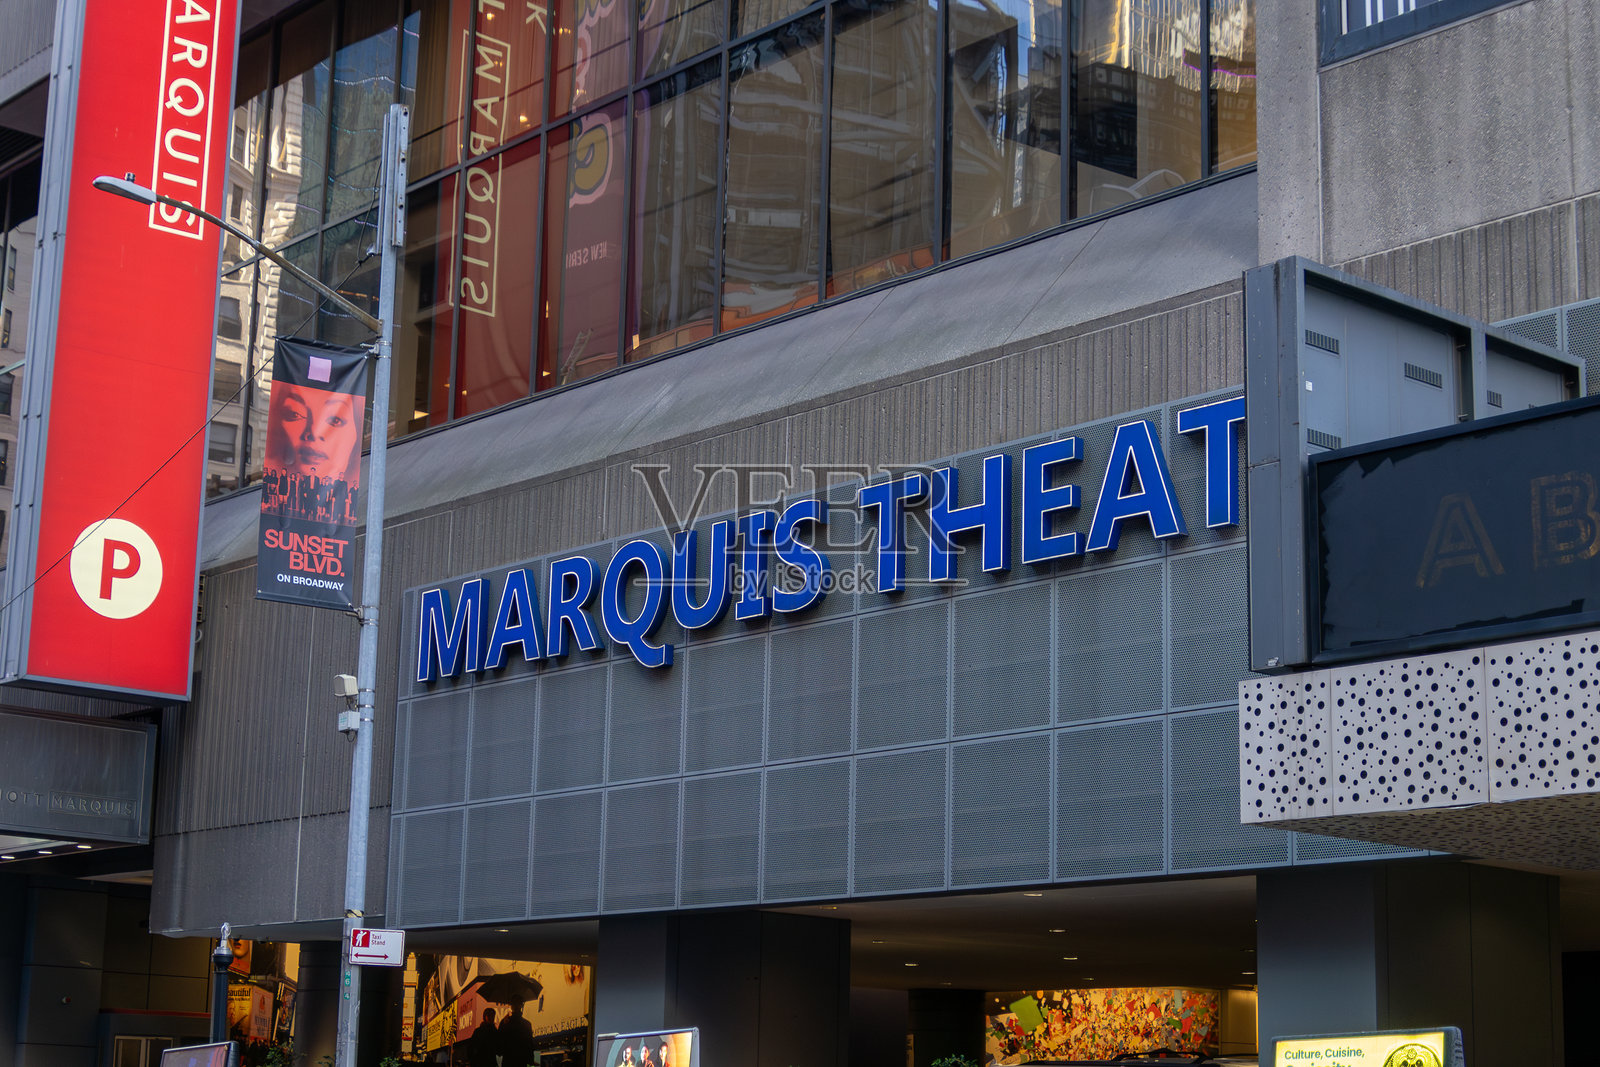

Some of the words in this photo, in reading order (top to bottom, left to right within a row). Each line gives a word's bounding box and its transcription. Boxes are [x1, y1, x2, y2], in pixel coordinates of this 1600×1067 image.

[264, 528, 349, 558] SUNSET
[416, 499, 832, 683] MARQUIS
[857, 395, 1246, 593] THEAT
[99, 538, 141, 600] P
[289, 550, 345, 577] BLVD.
[276, 573, 291, 583] ON
[292, 575, 344, 591] BROADWAY
[51, 793, 133, 816] MARQUIS
[1284, 1050, 1323, 1061] Culture,
[1324, 1047, 1365, 1059] Cuisine,
